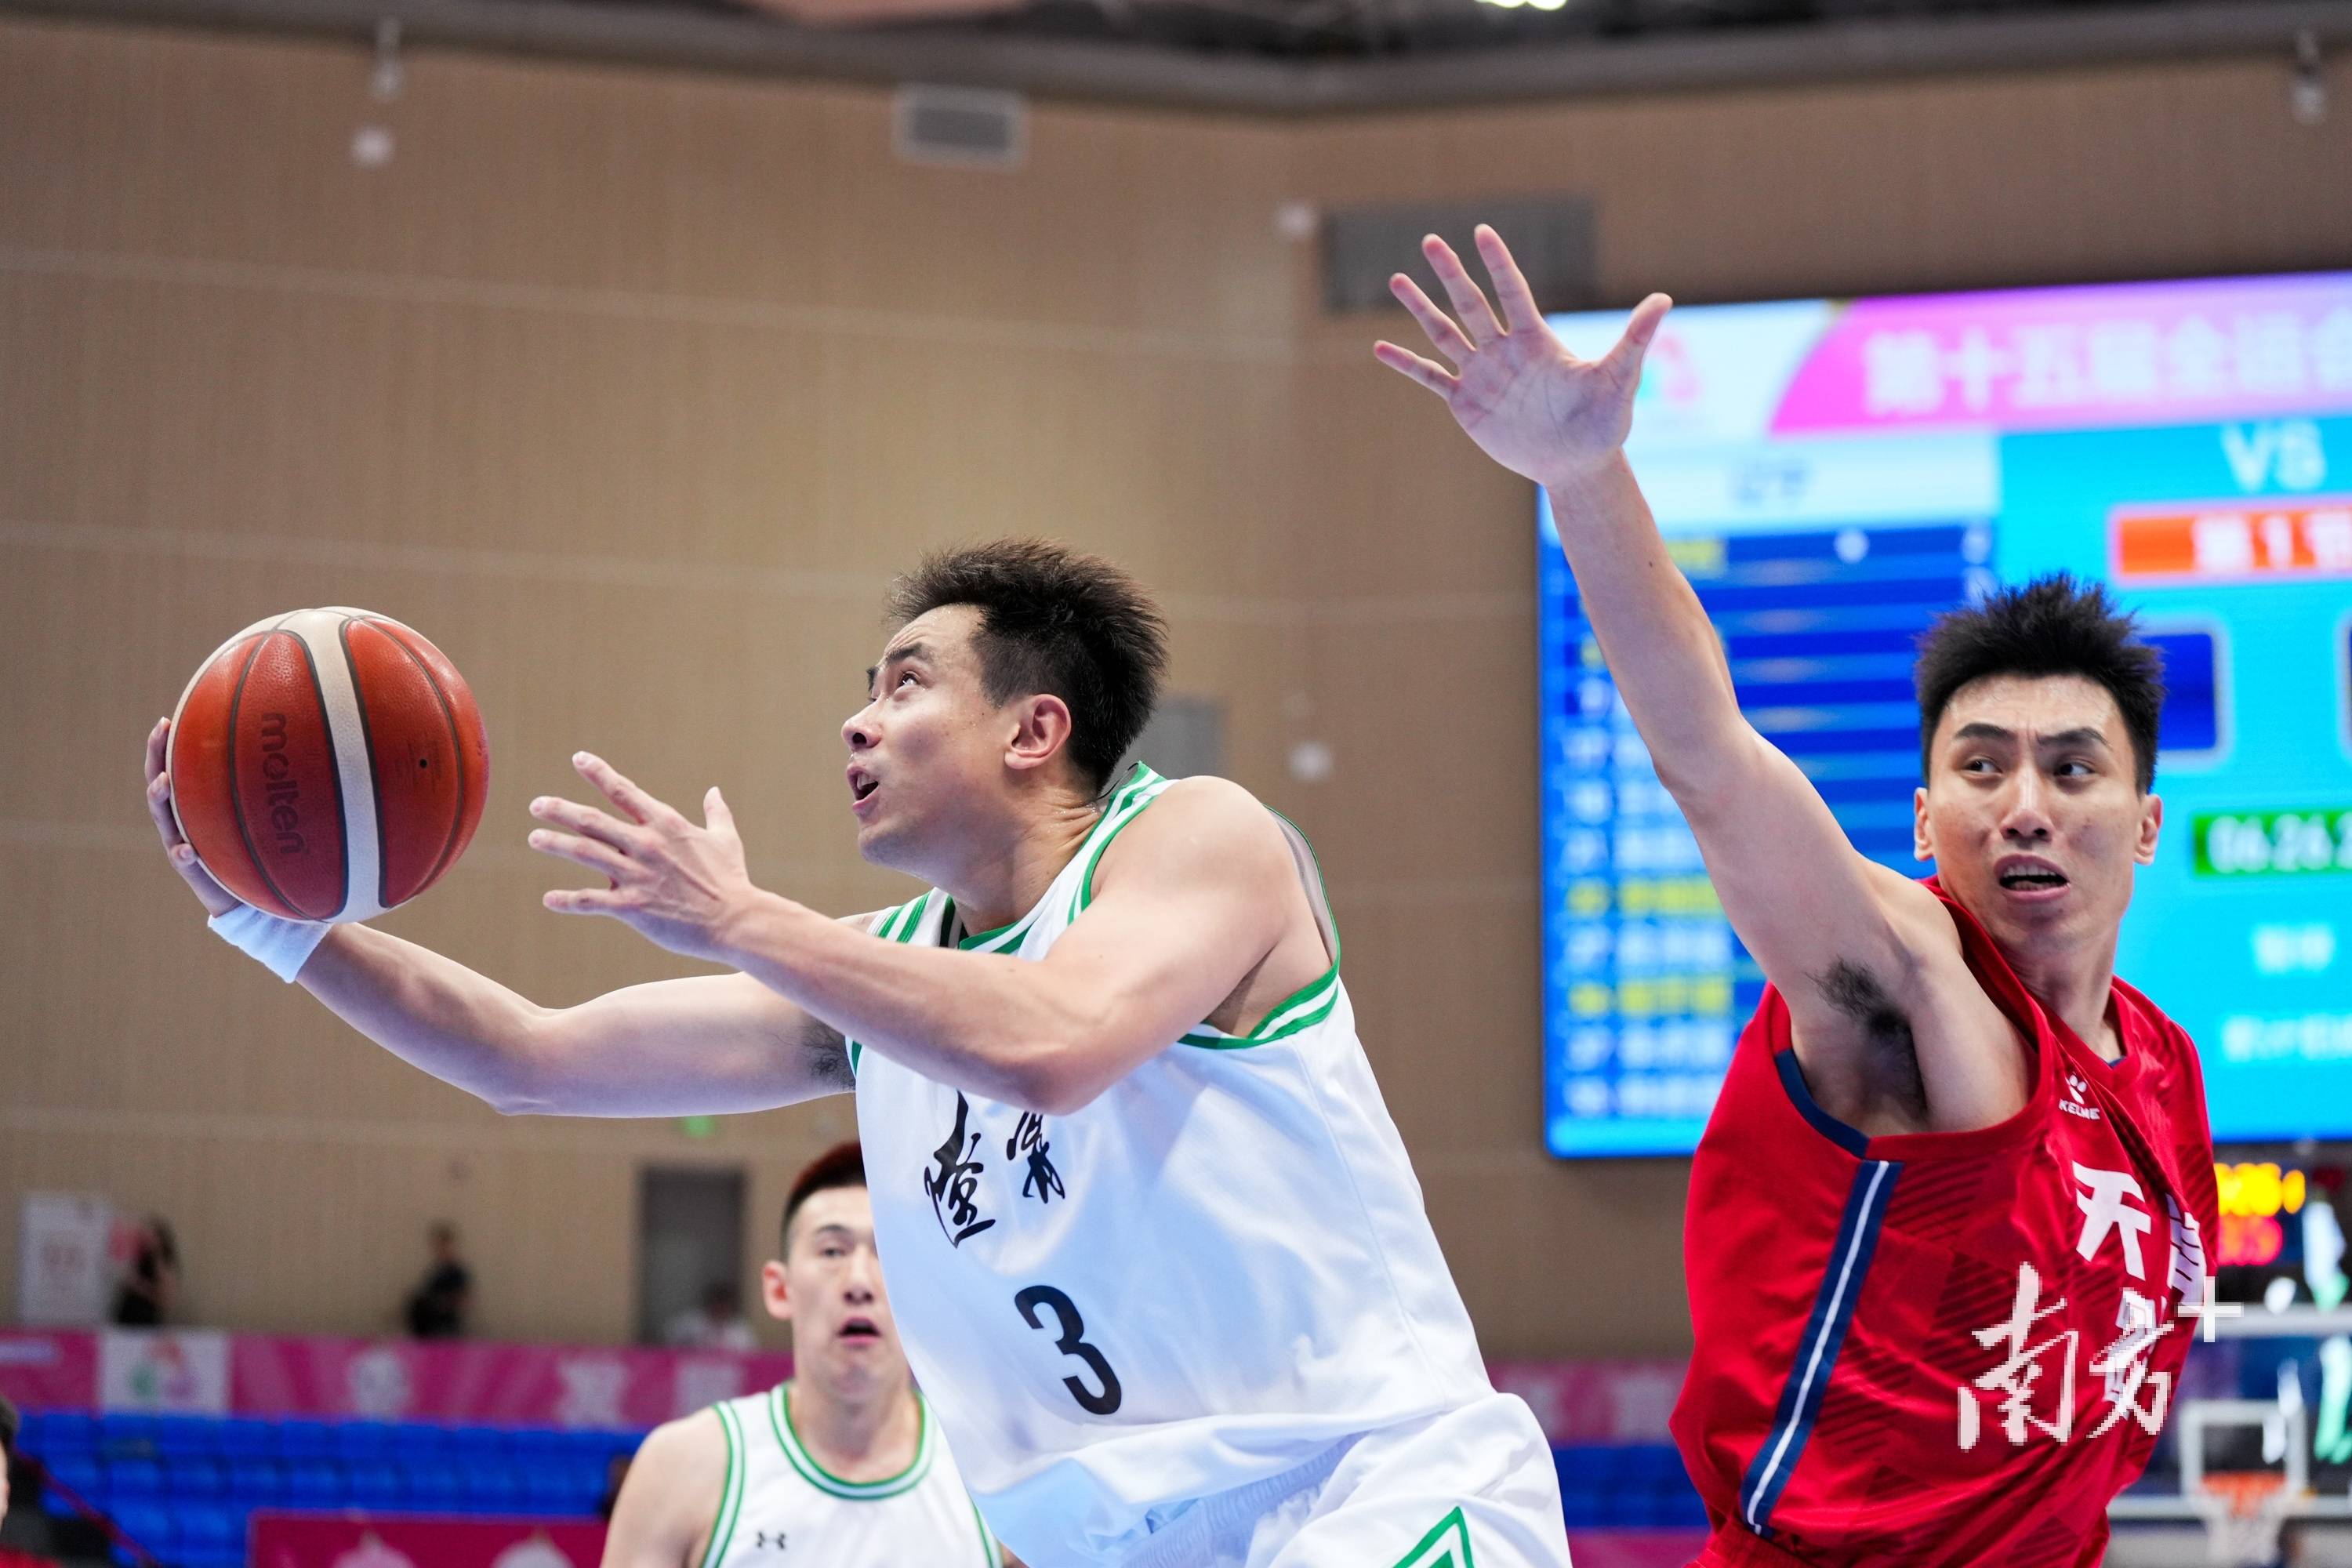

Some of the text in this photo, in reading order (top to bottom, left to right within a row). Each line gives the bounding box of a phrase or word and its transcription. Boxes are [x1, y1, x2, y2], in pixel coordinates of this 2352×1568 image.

[2220, 419, 2326, 492] VS
[261, 713, 307, 855] molten
[1014, 1285, 1122, 1415] 3
